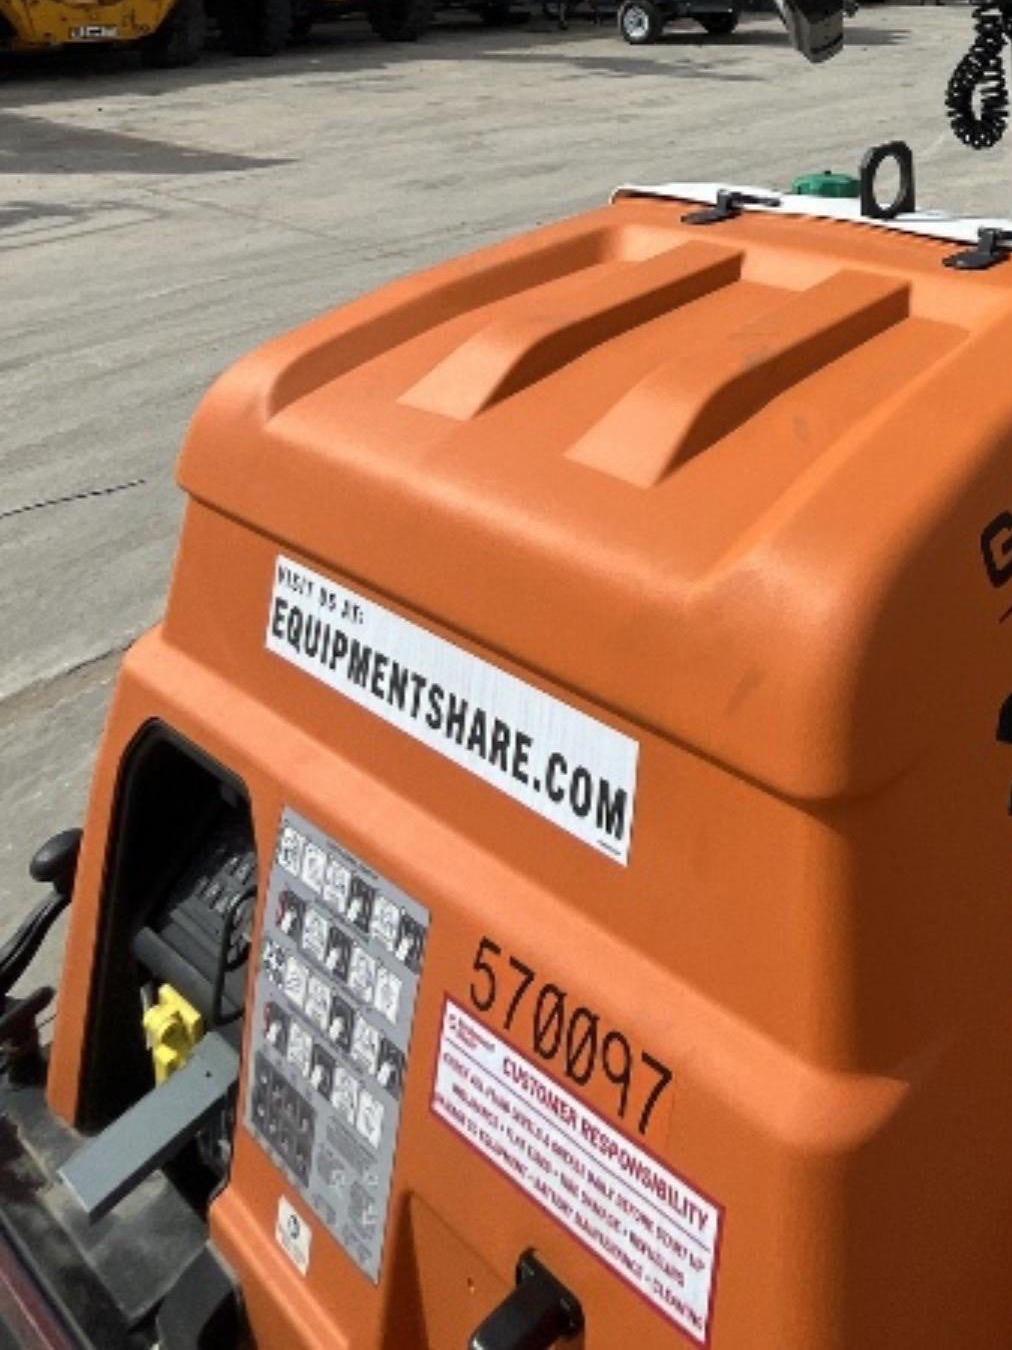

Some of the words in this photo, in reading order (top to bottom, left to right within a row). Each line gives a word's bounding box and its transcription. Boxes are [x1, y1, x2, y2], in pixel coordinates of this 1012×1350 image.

[271, 597, 628, 841] EQUIPMENTSHARE.COM
[470, 938, 672, 1134] 570097
[503, 1058, 577, 1132] CUSTOMER
[581, 1117, 709, 1230] RESPONSIBILITY
